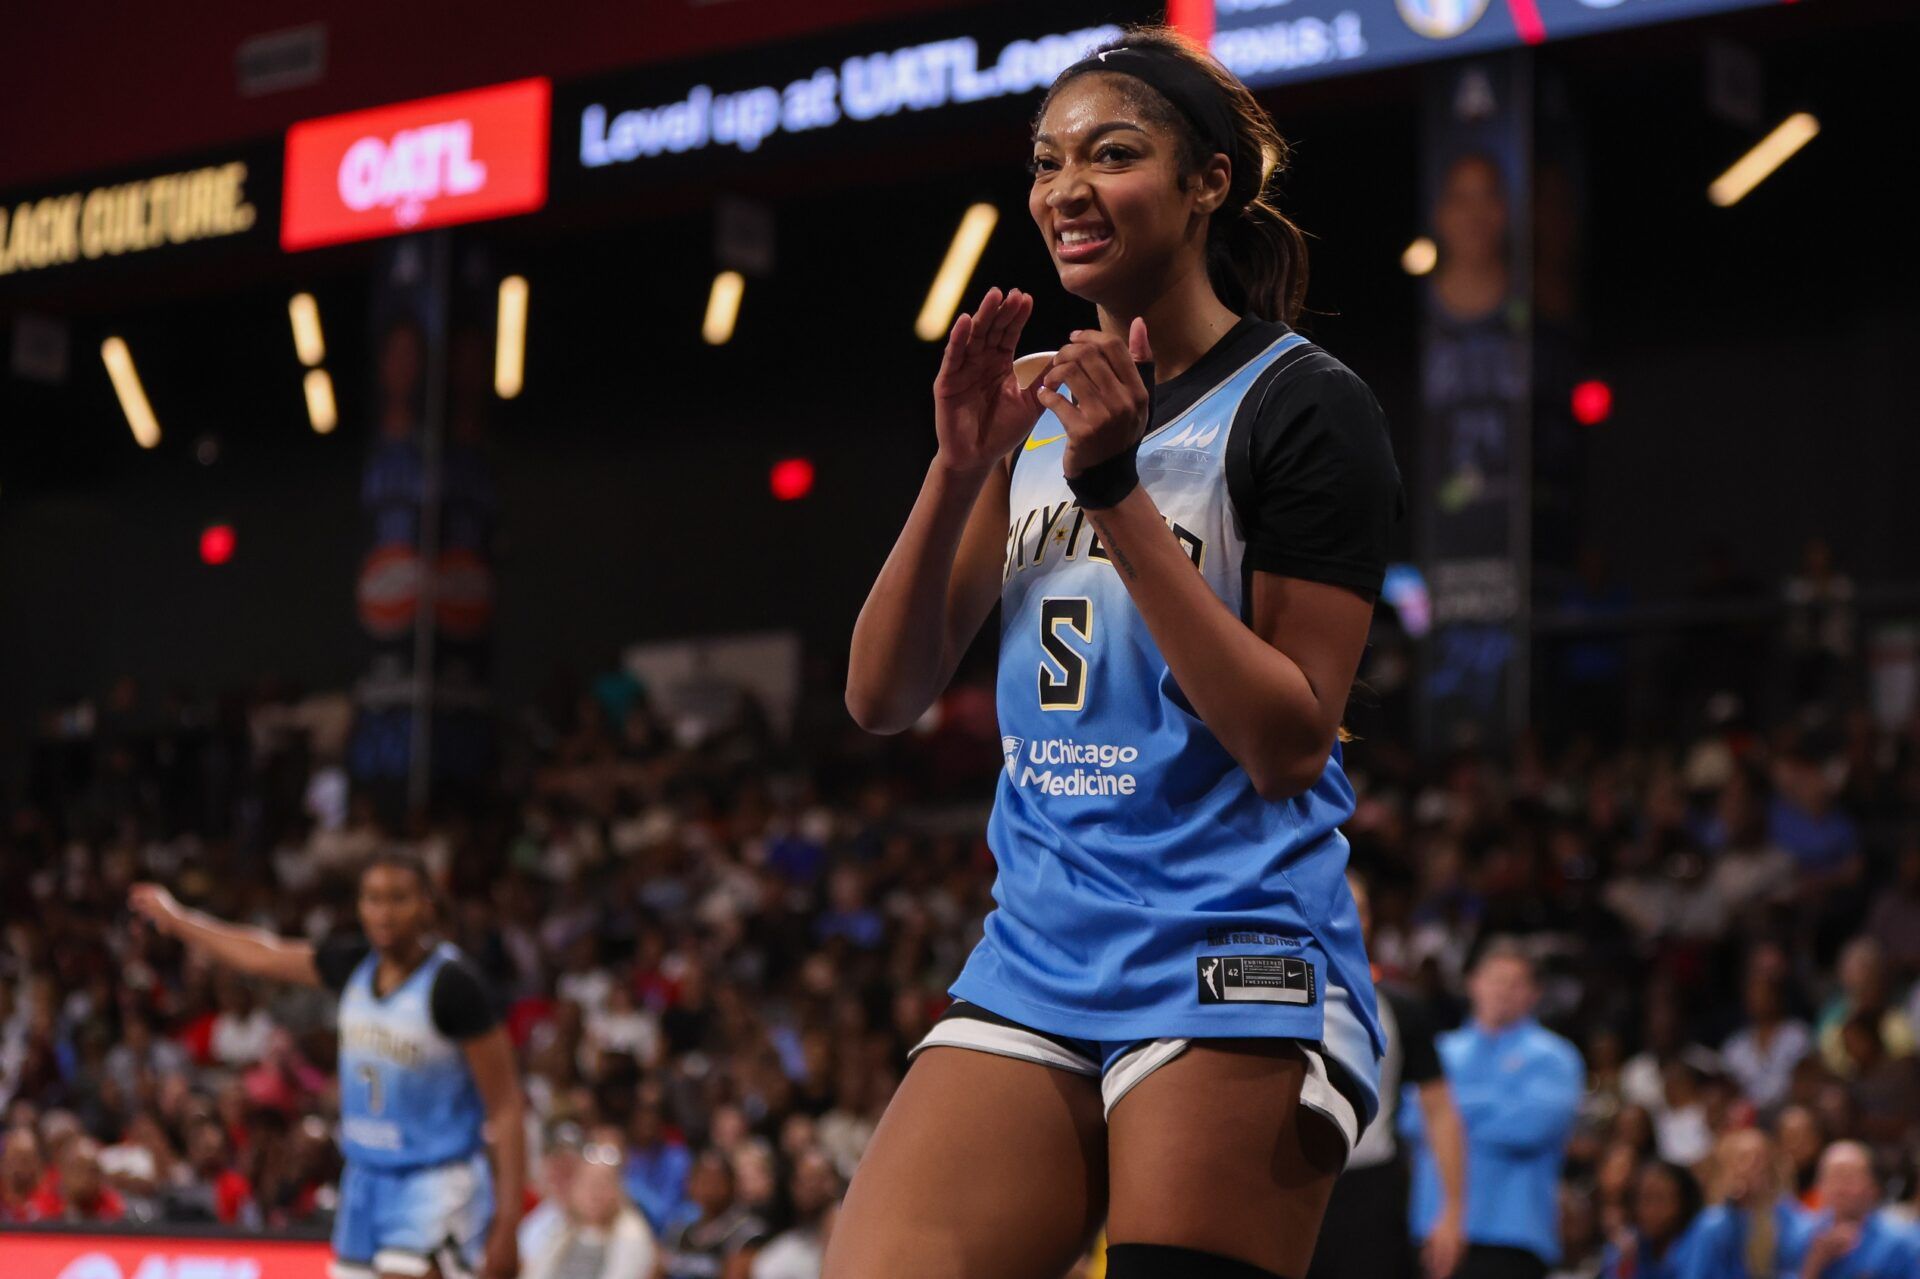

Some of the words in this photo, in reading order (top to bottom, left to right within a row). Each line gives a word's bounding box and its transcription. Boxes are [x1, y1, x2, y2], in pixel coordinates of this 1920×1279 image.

[580, 102, 711, 167] Level
[713, 85, 780, 153] up
[781, 69, 841, 132] at
[1038, 596, 1093, 712] 5
[1029, 738, 1139, 768] UChicago
[1020, 765, 1137, 796] Medicine
[1263, 935, 1302, 948] EDITION
[1228, 968, 1239, 977] 42
